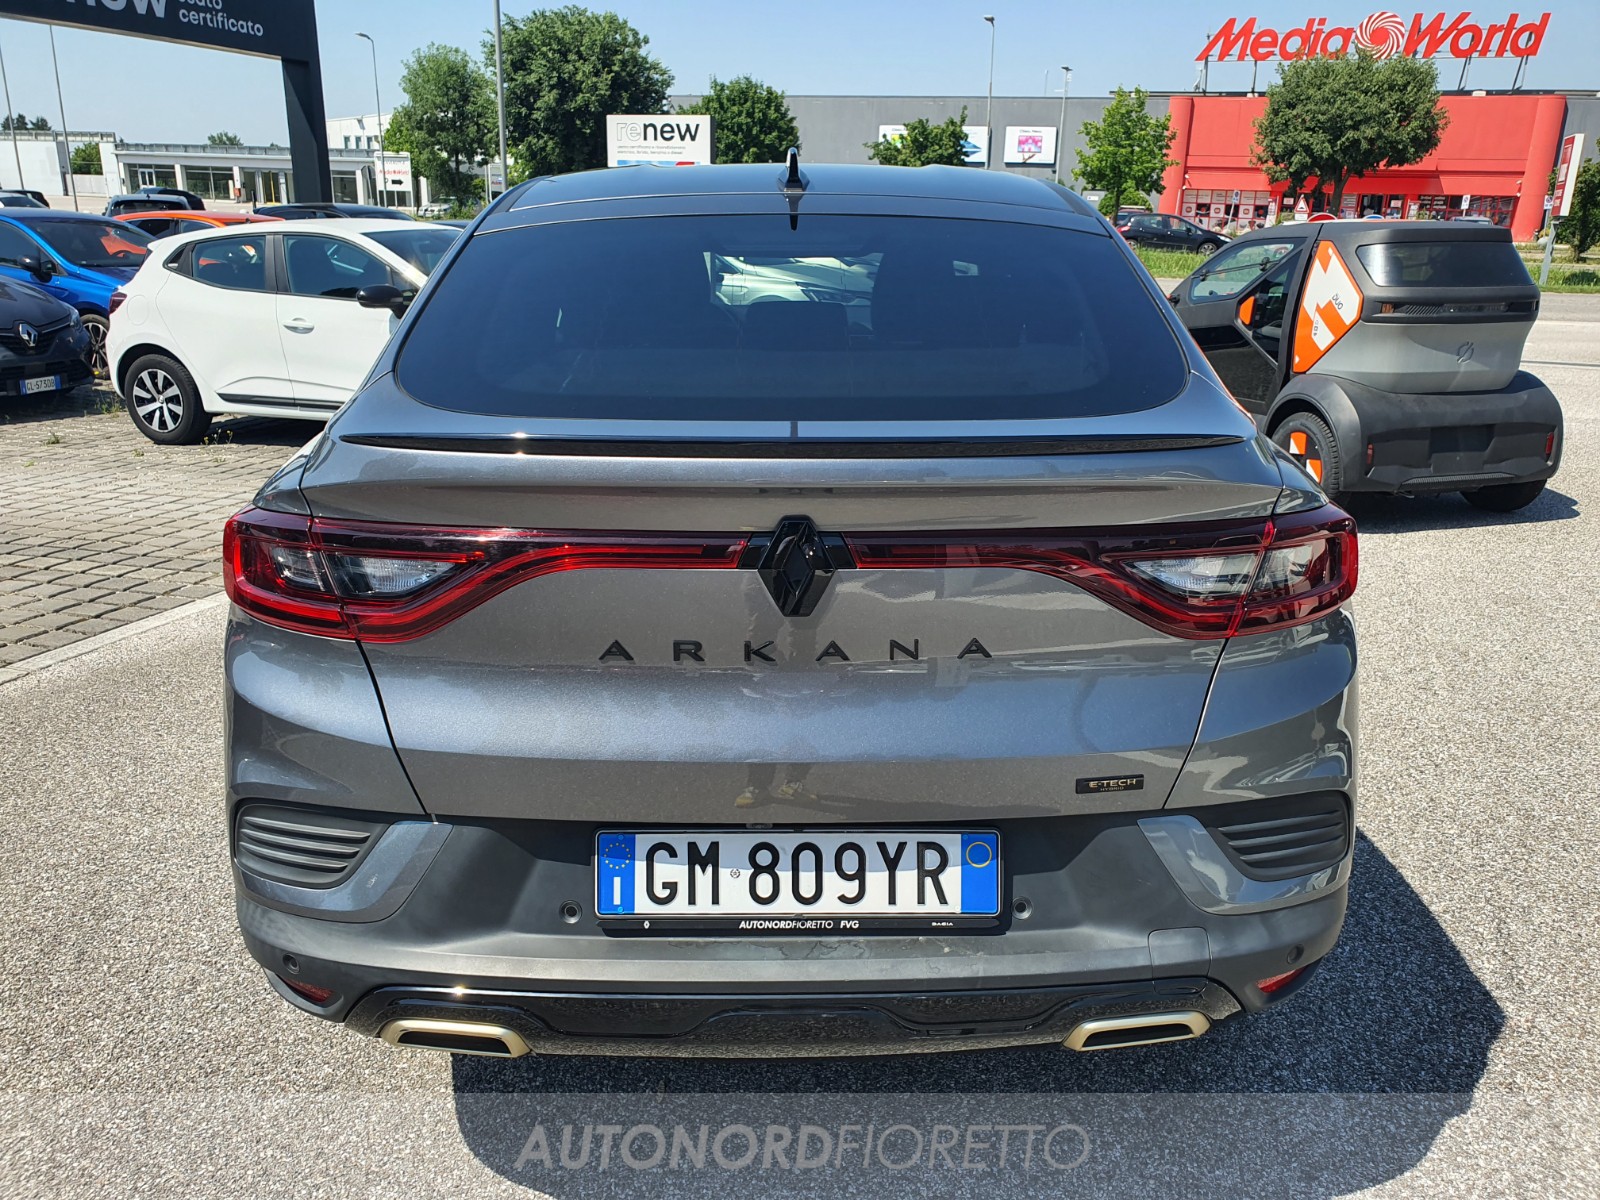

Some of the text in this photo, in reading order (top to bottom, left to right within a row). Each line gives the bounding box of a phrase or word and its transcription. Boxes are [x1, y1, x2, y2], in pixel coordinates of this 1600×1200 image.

[179, 0, 223, 9] ato
[179, 9, 264, 36] certificato
[1195, 12, 1552, 61] Media World
[616, 122, 700, 141] renew
[599, 637, 993, 662] ARKANA
[1088, 778, 1137, 788] E-TECH
[645, 841, 720, 906] GM
[748, 841, 950, 906] 809YR
[738, 920, 860, 929] AUTONORDFIORETTO FVG
